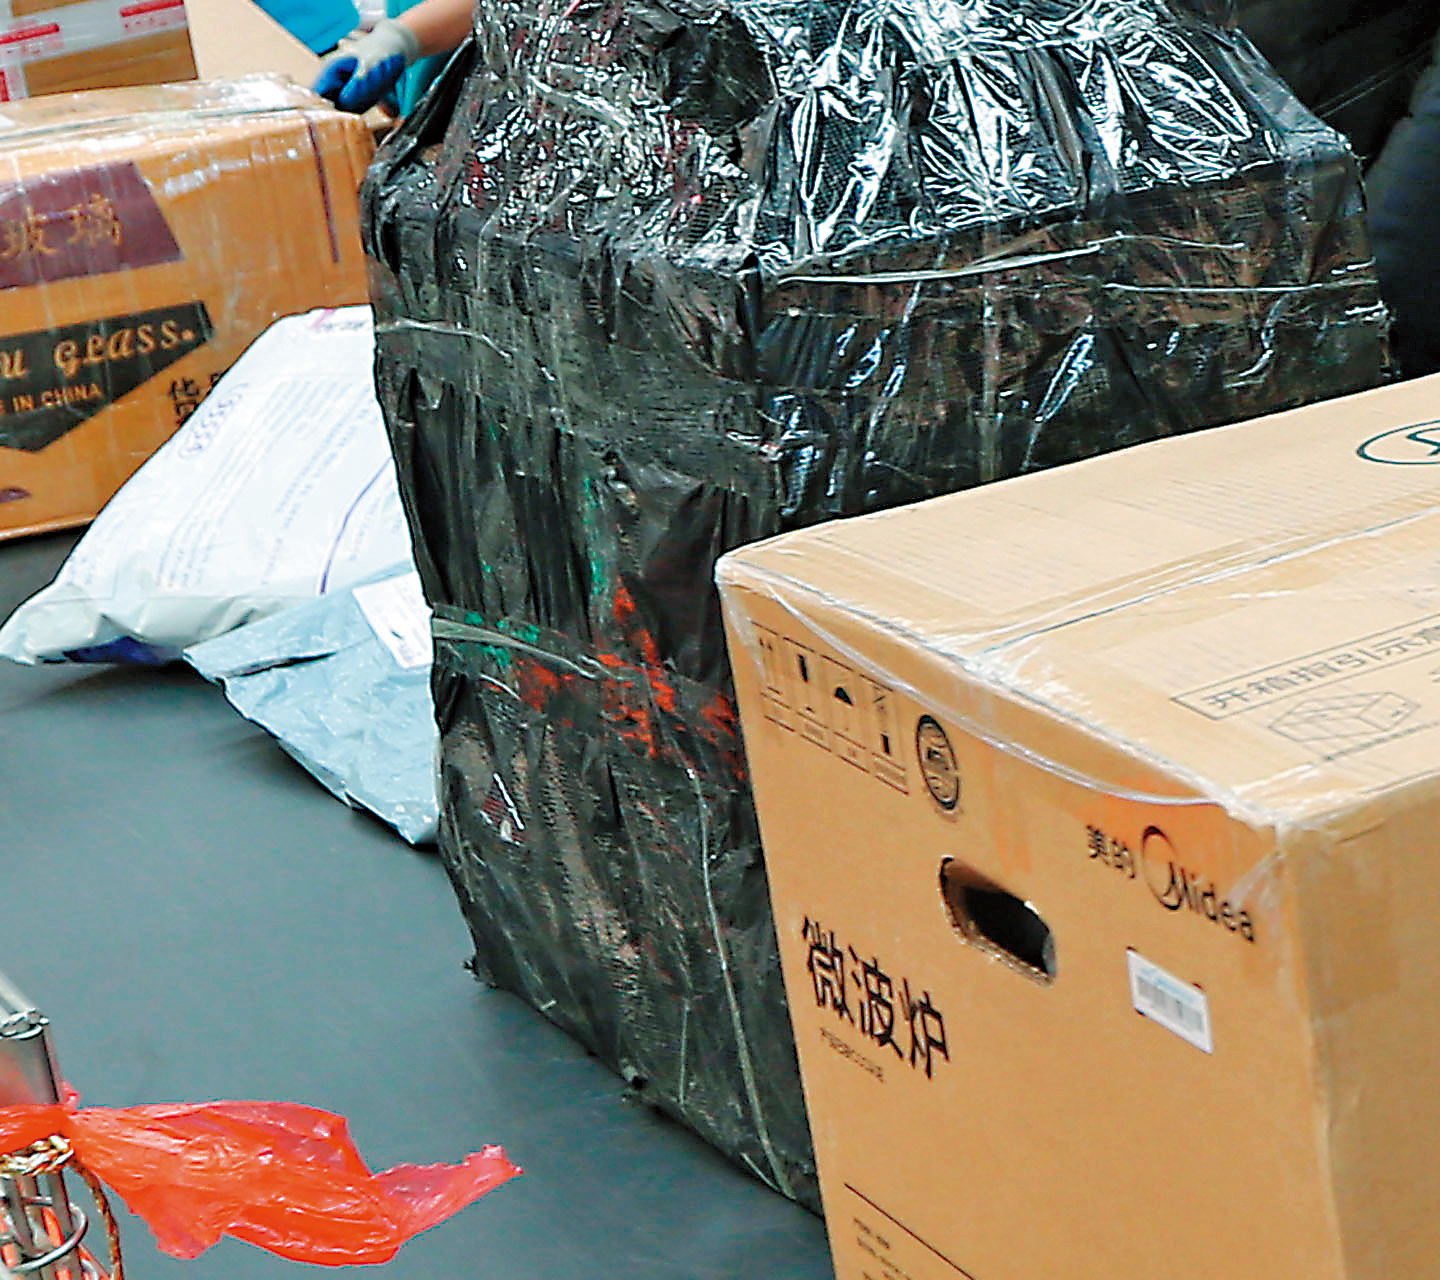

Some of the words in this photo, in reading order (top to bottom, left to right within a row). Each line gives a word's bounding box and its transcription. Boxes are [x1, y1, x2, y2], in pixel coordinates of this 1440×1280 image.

[41, 383, 102, 406] CHINA
[1086, 823, 1137, 880] 美的
[1143, 830, 1257, 943] Midea
[803, 916, 950, 1079] 微波炉
